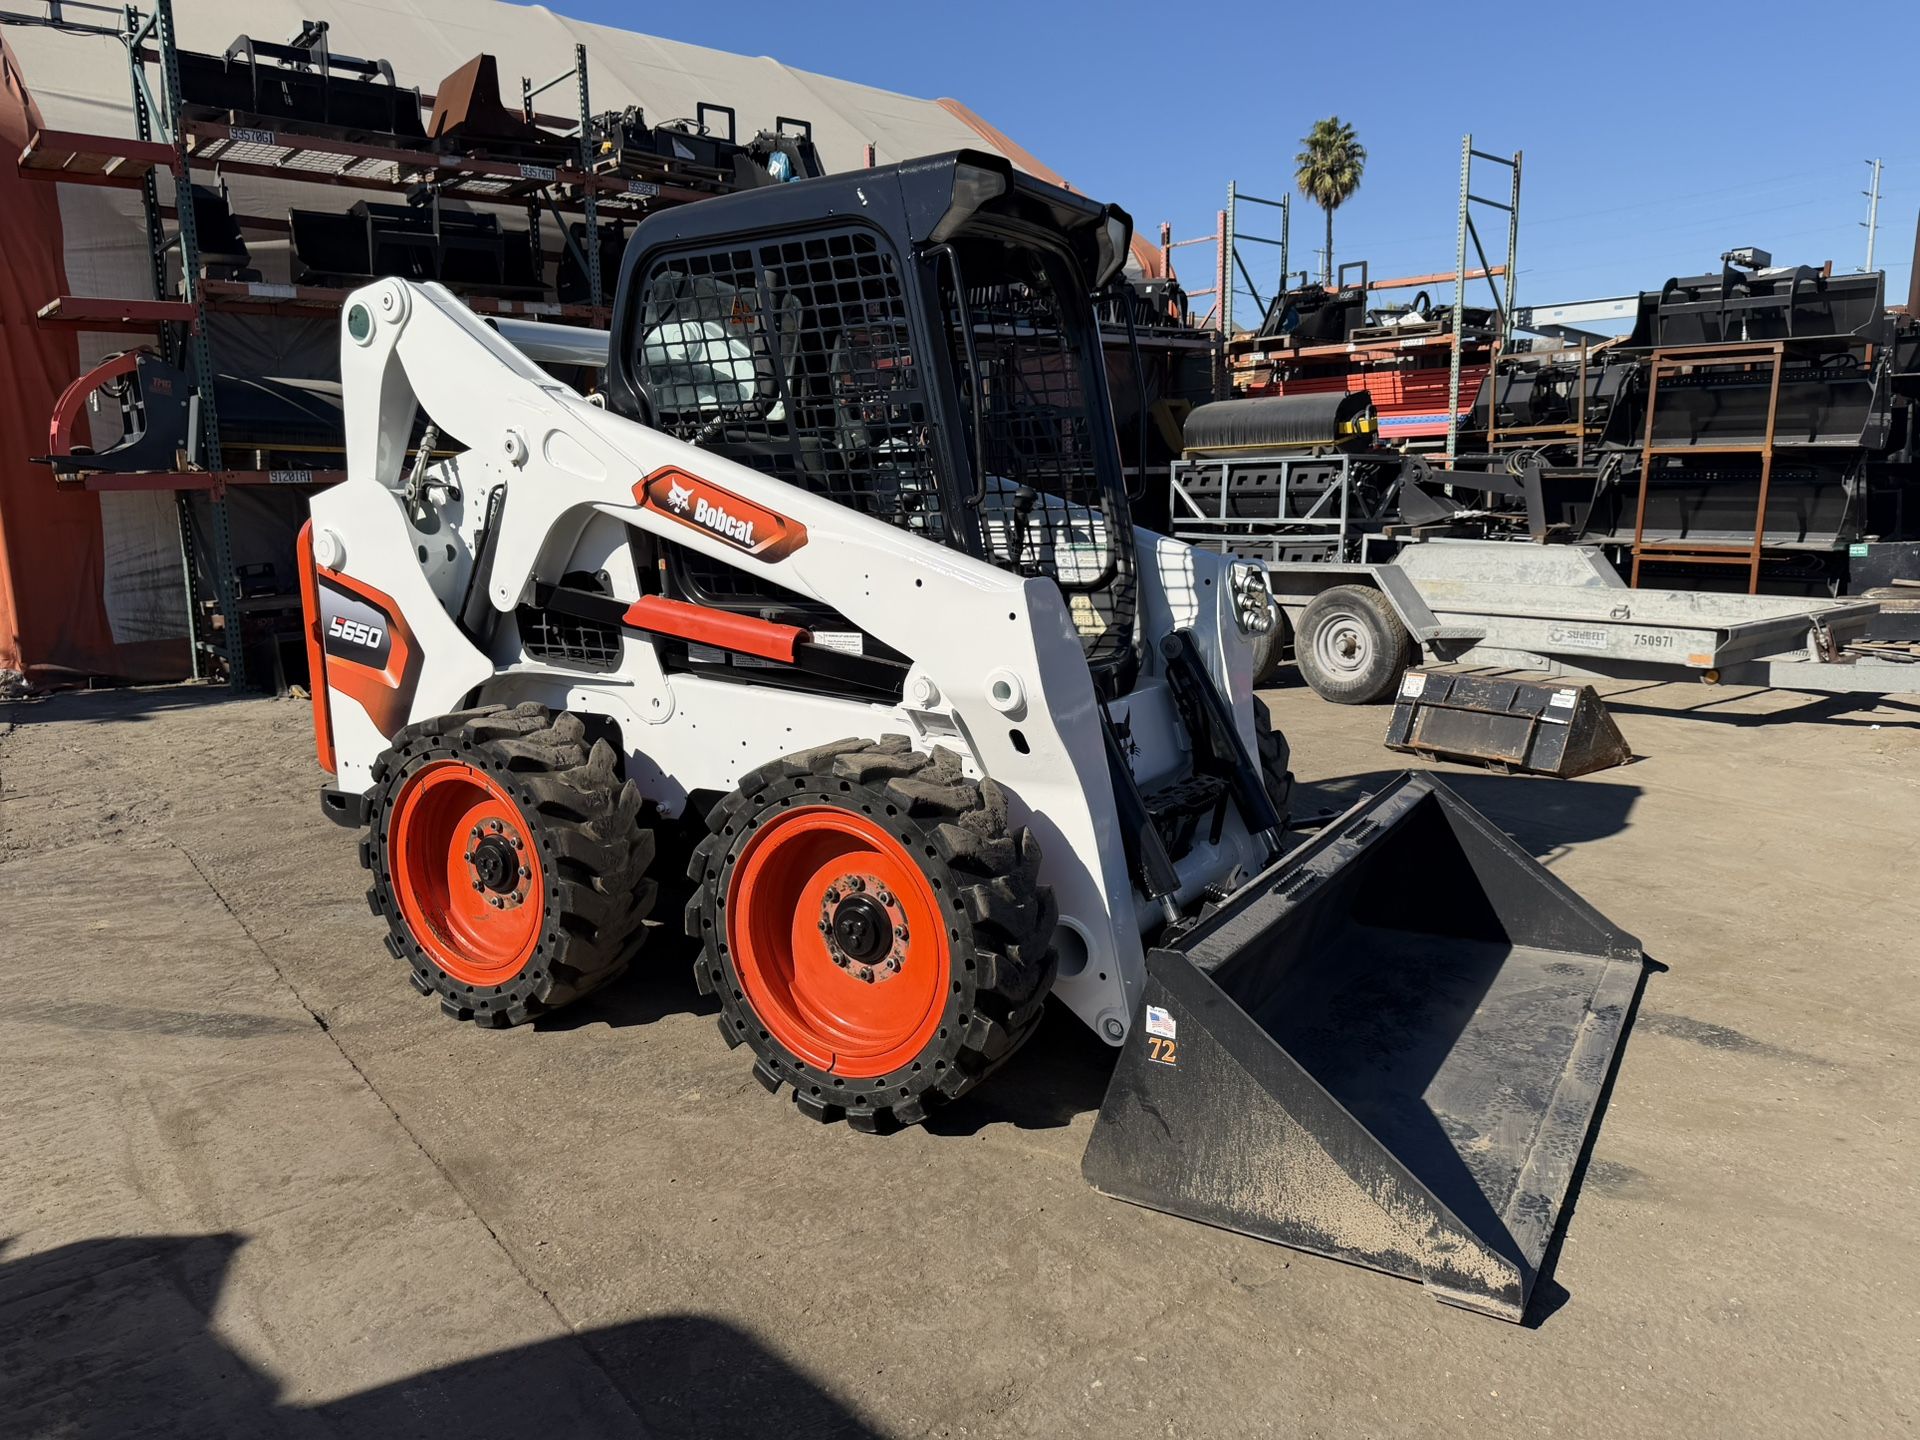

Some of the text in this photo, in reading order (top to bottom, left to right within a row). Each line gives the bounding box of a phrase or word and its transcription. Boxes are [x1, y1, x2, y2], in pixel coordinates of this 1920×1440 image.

[694, 497, 755, 546] Bobcat
[328, 616, 383, 649] S650
[1634, 634, 1673, 647] 750971
